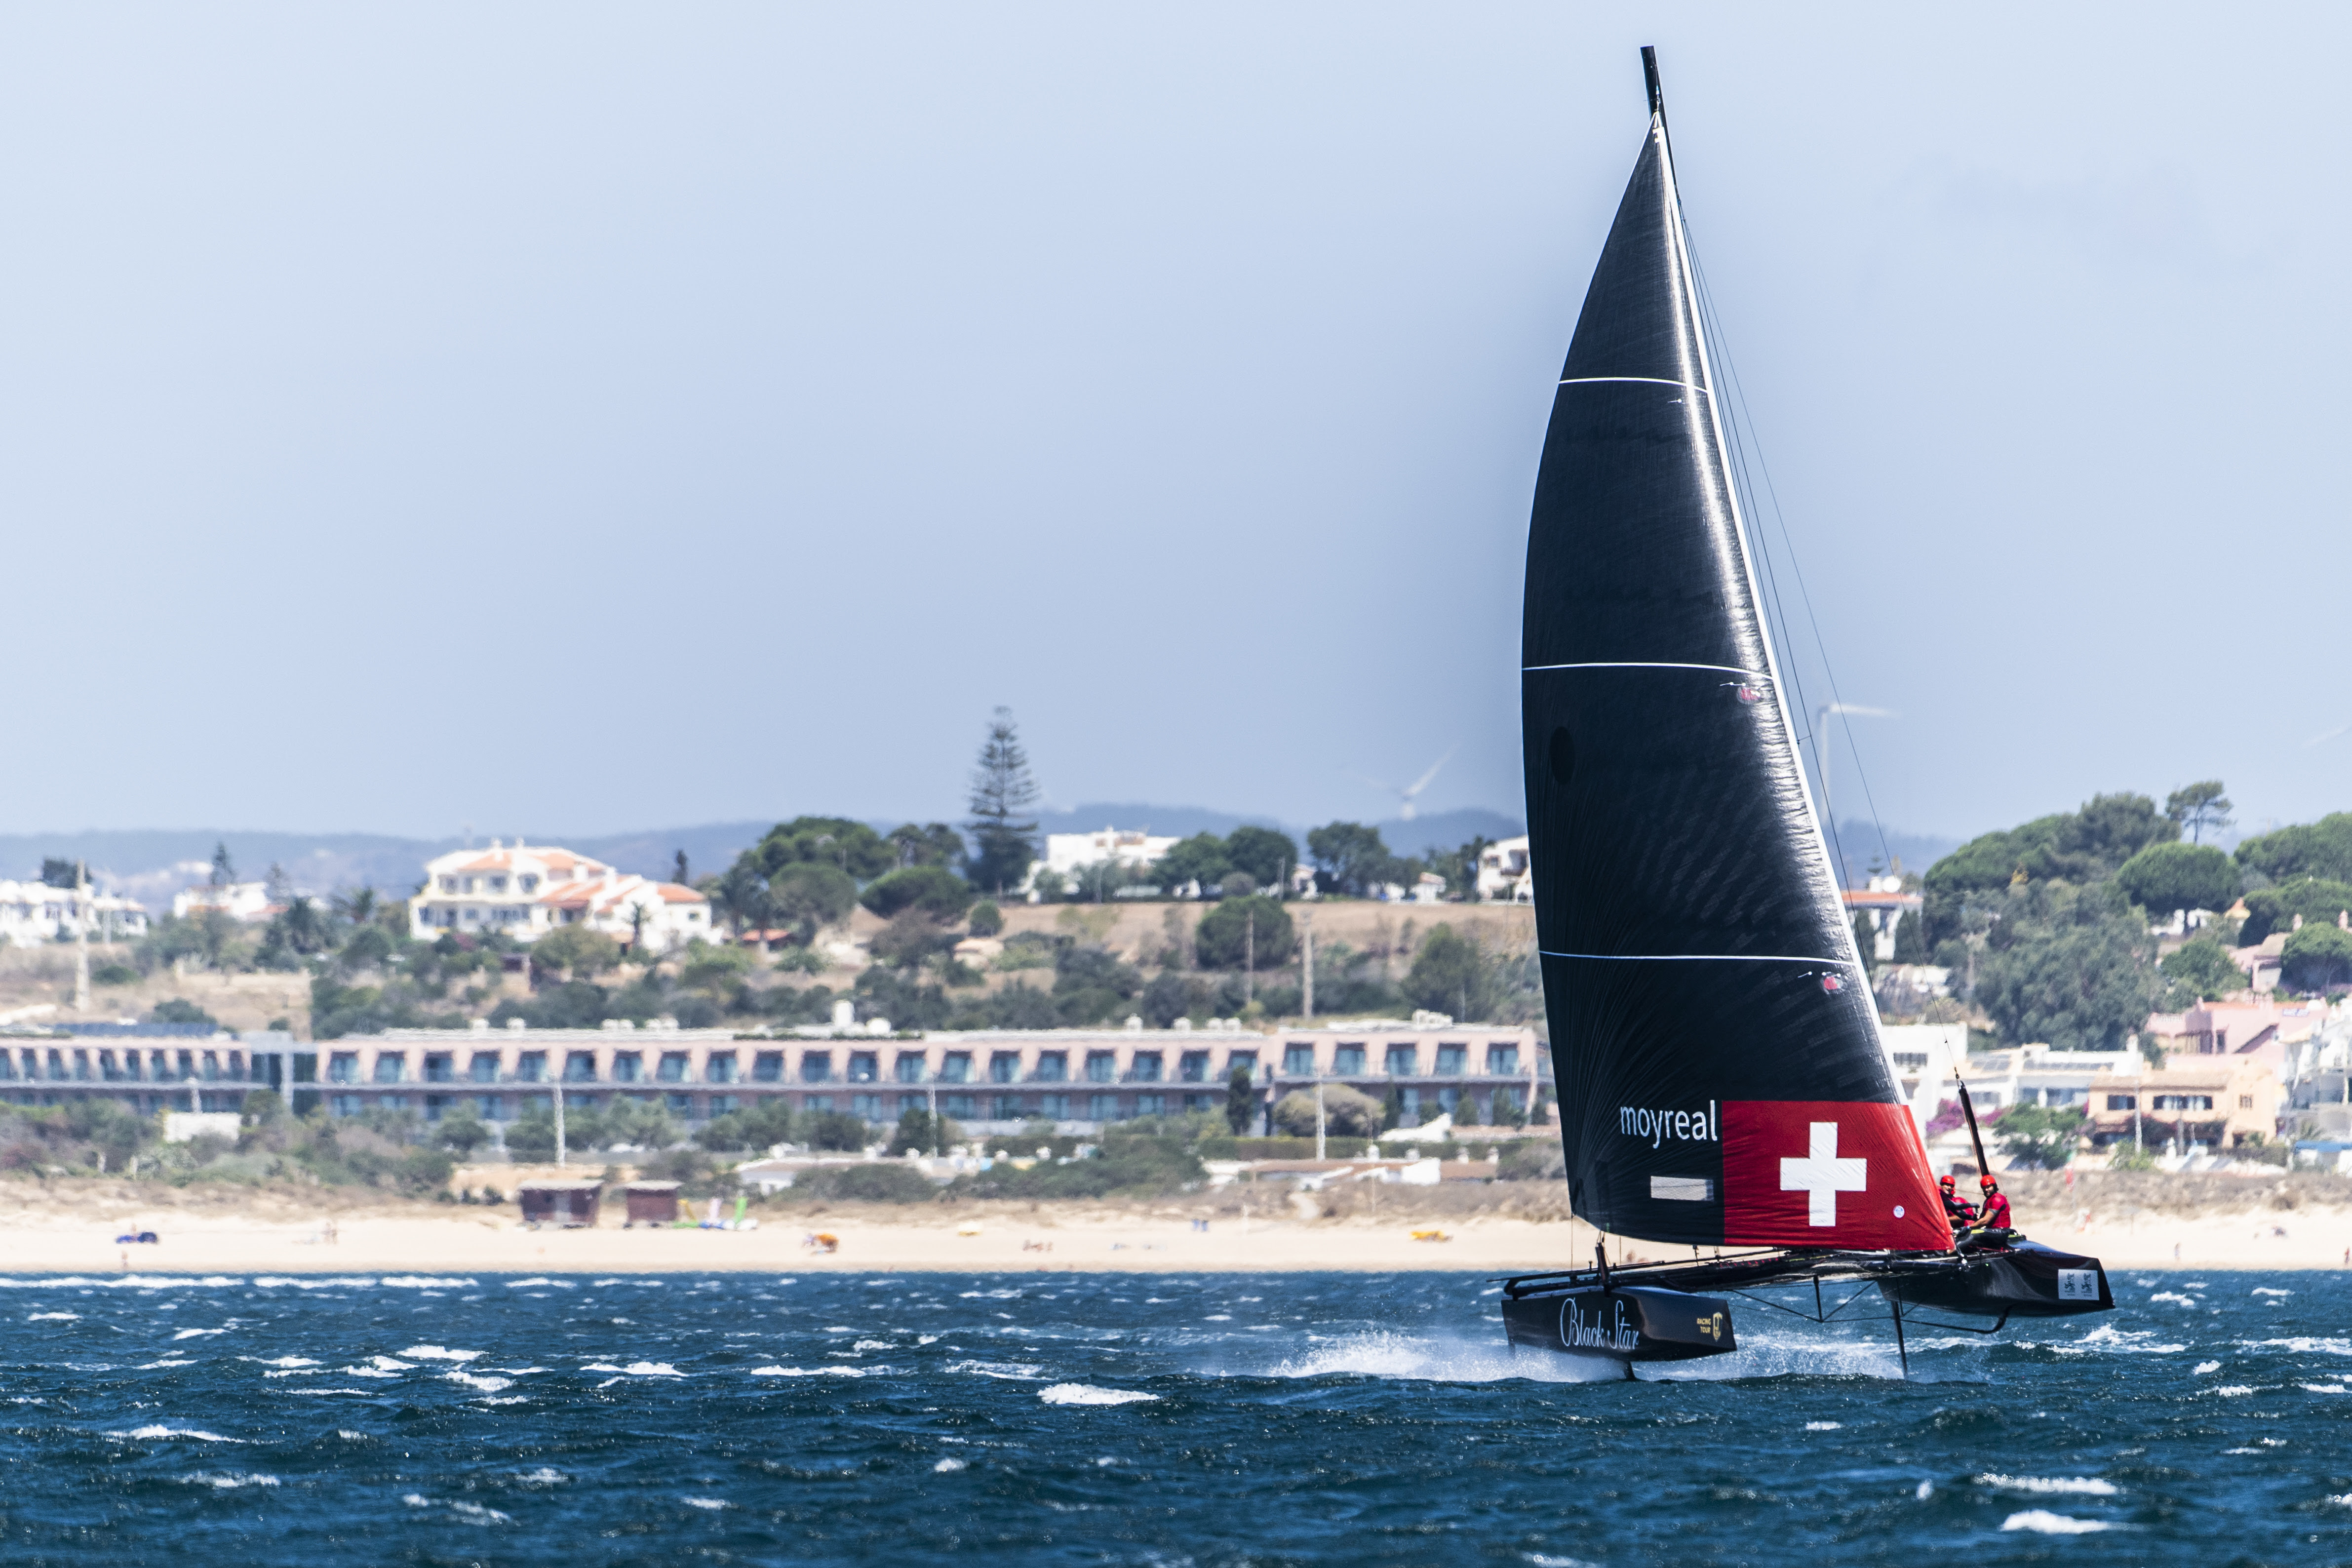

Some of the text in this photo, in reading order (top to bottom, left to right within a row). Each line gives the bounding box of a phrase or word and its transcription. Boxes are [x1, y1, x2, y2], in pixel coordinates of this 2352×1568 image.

[1620, 1099, 1718, 1149] moyreal
[1560, 1297, 1639, 1350] Black Star
